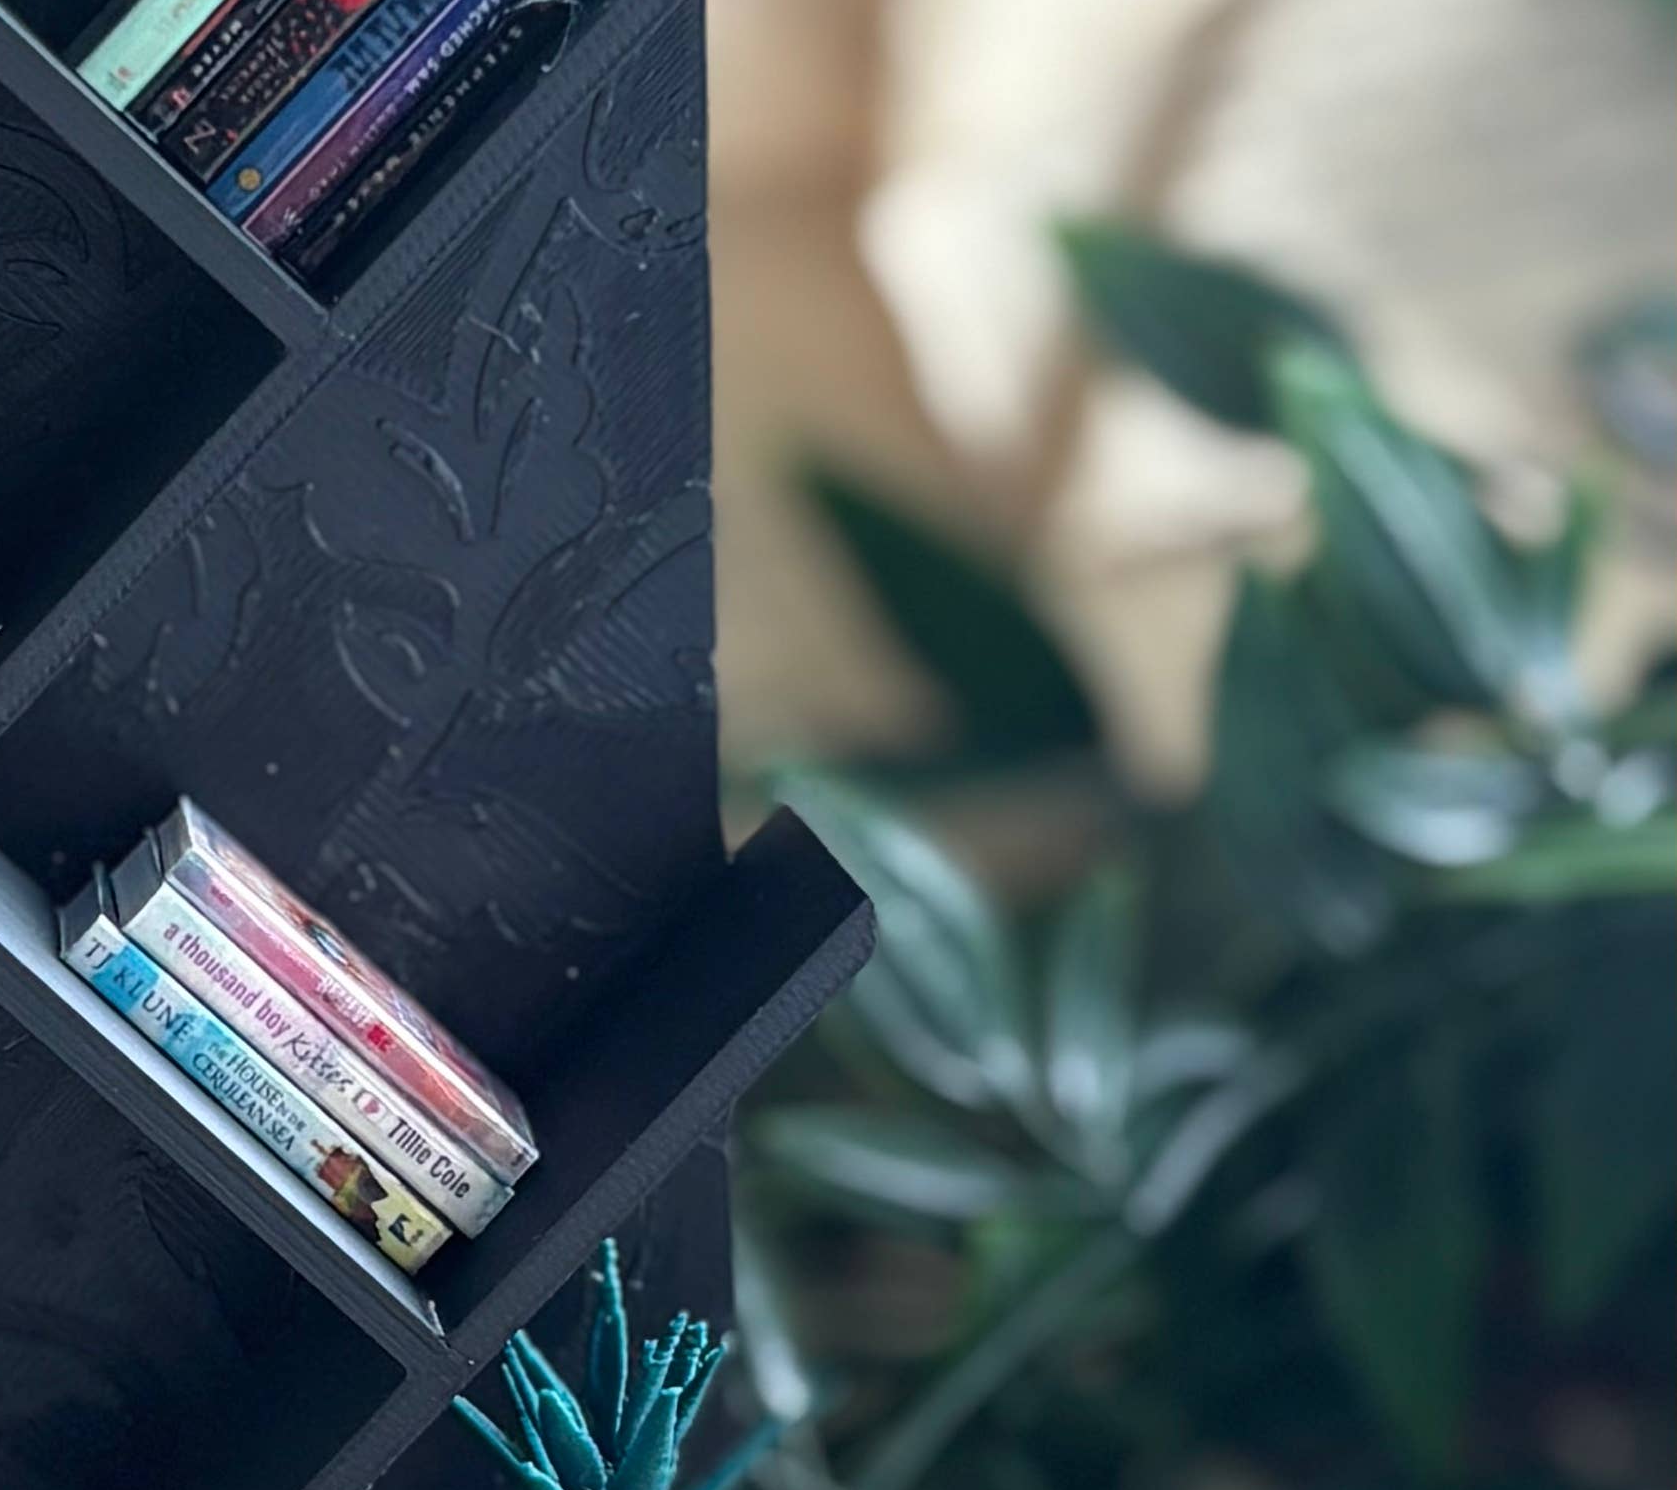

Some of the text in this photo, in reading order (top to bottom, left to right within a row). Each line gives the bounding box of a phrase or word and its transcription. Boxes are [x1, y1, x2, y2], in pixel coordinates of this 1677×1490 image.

[399, 54, 443, 98] SAM
[110, 963, 197, 1045] KLUNE
[160, 920, 182, 943] a
[175, 929, 263, 1010] thousand
[250, 997, 296, 1043] boy
[187, 1048, 300, 1152] CERULEAN SEA
[224, 1050, 286, 1108] HOUSE
[384, 1116, 477, 1201] Tillie Cole
